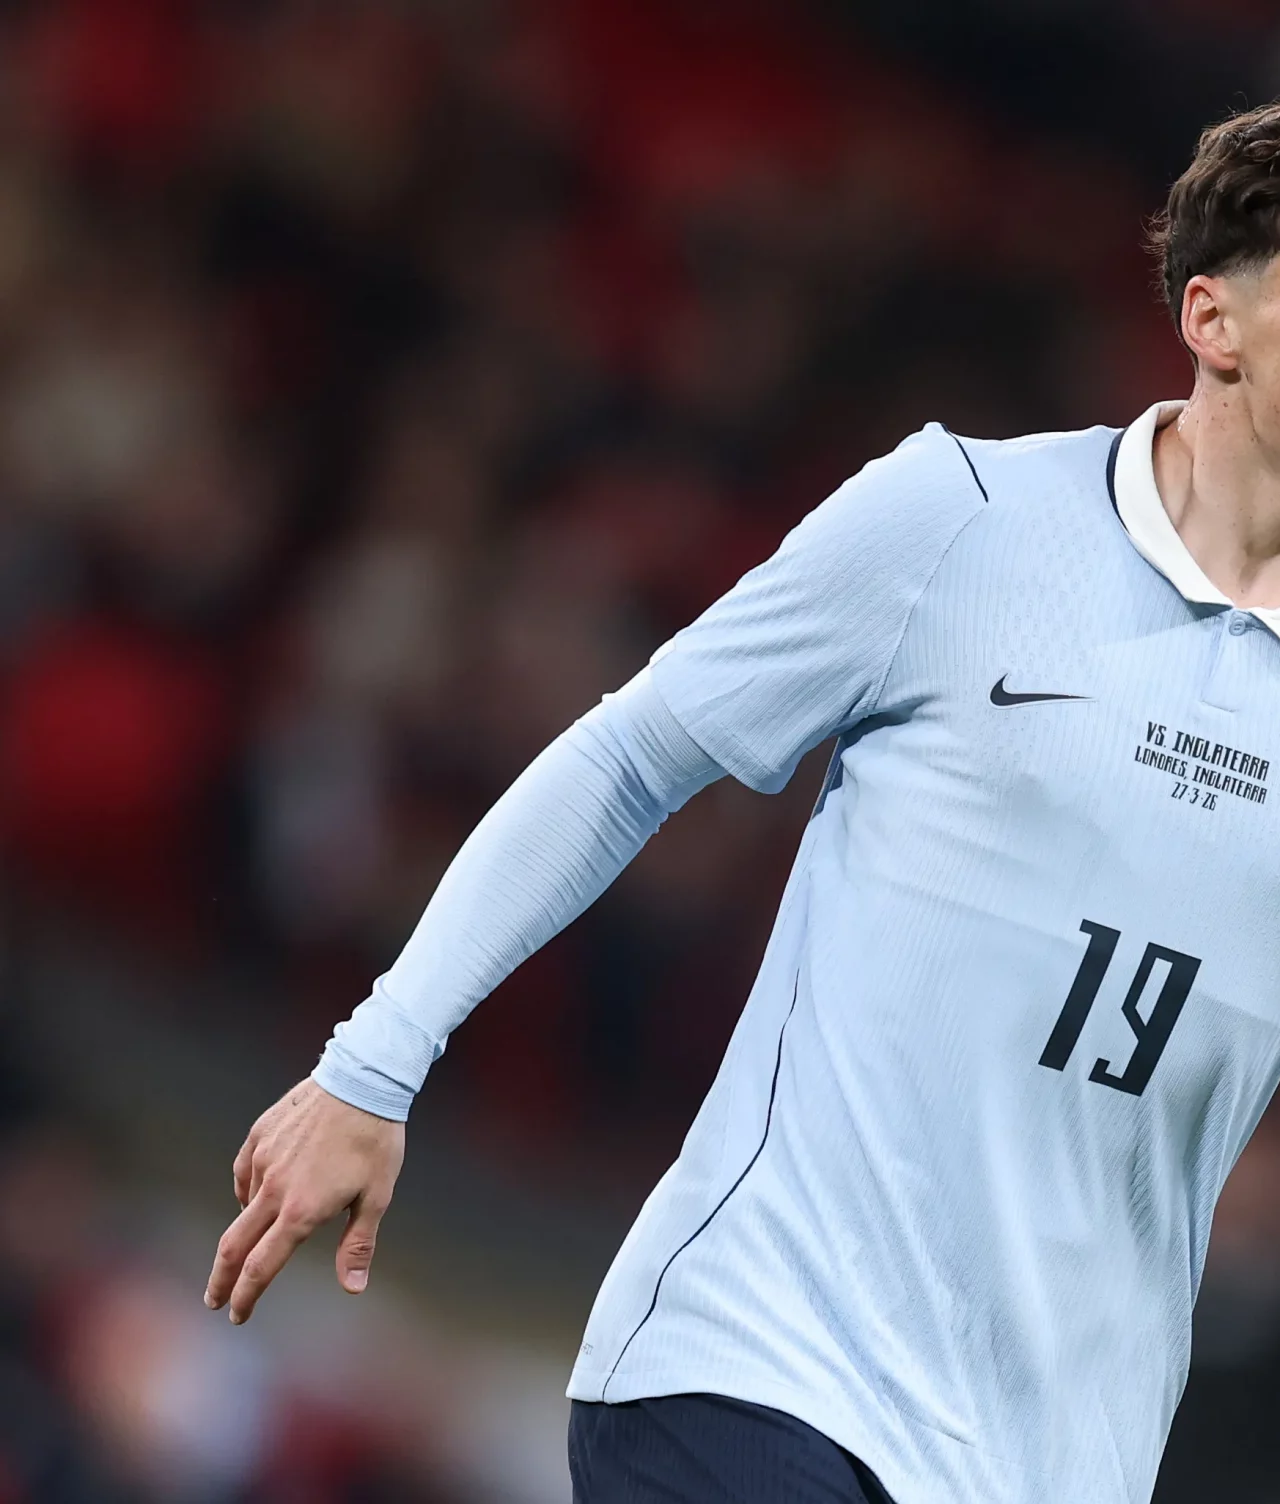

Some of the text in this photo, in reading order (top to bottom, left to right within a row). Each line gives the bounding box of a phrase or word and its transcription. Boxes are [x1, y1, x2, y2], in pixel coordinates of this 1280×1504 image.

[1134, 745, 1267, 805] LONDRES, INGLATERRA
[1146, 720, 1270, 782] VS. INGLATERRA
[1038, 918, 1203, 1097] 19
